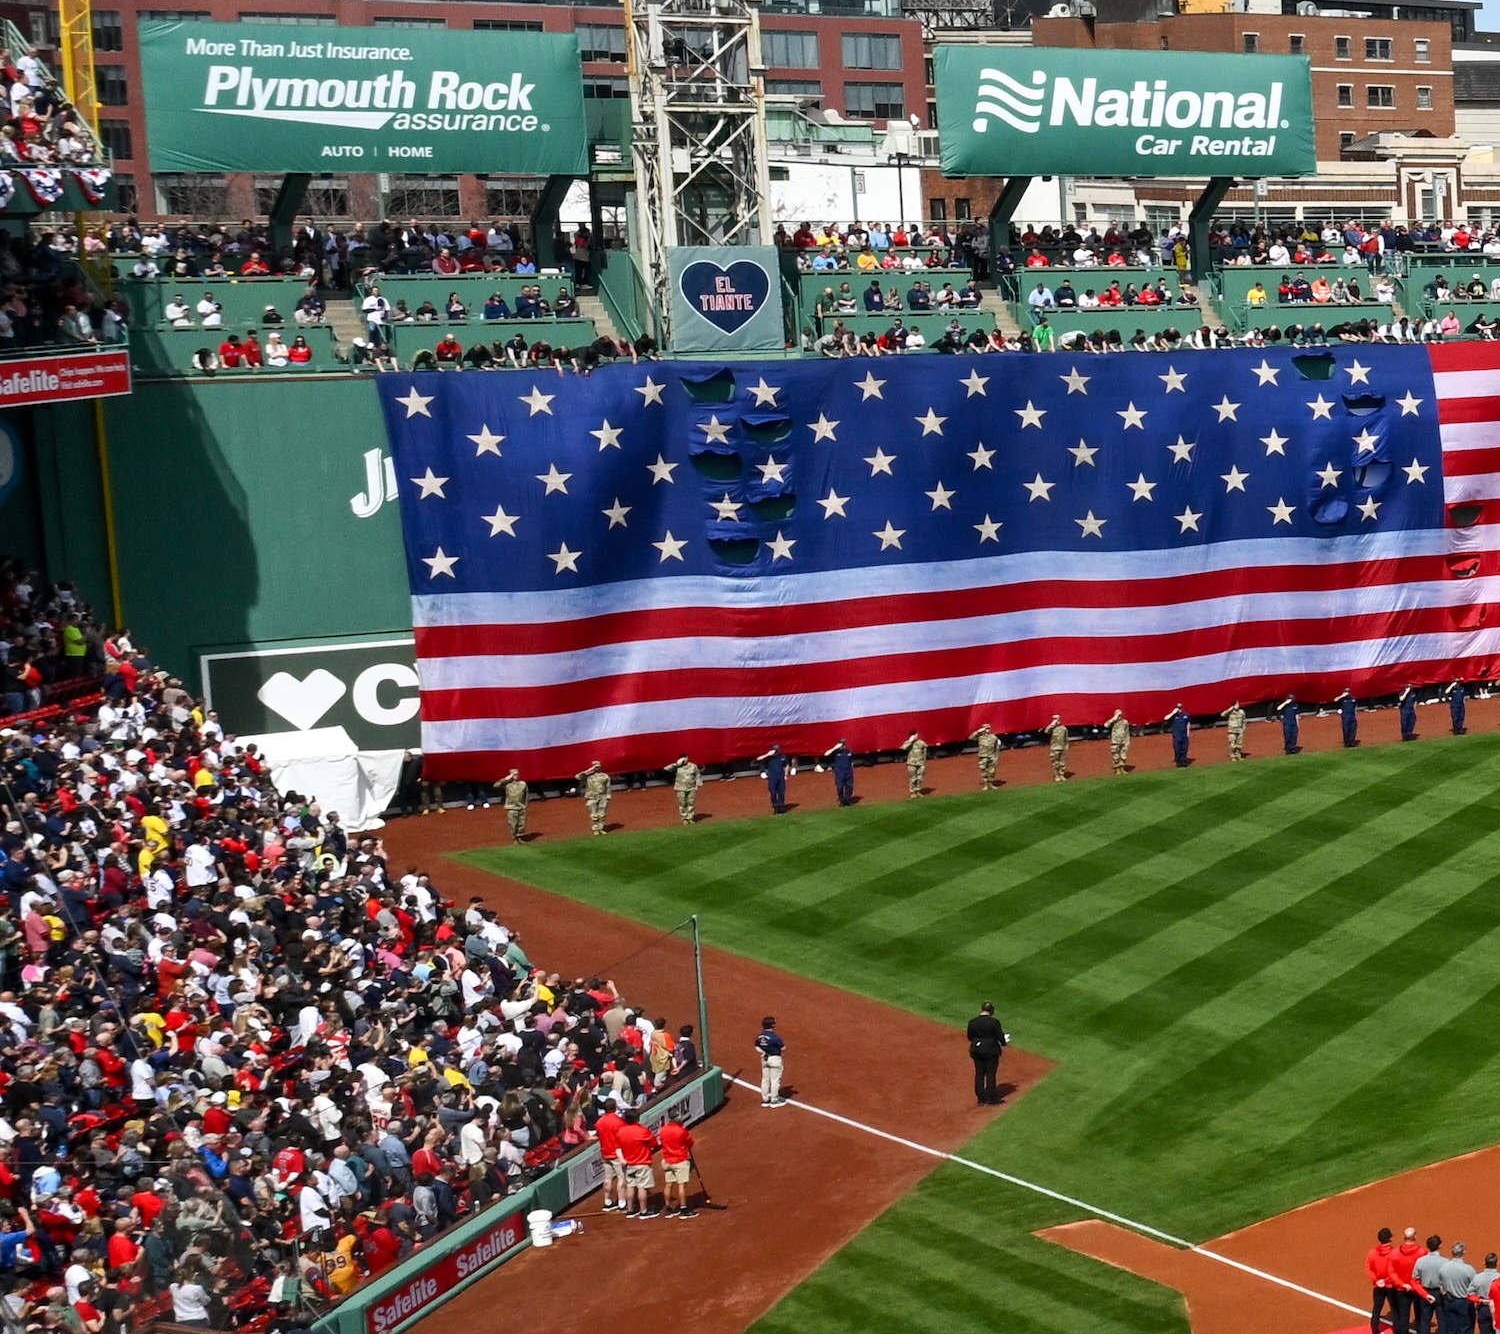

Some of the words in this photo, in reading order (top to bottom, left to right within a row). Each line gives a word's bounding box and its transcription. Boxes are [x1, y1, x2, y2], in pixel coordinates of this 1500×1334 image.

[186, 38, 236, 56] More
[240, 39, 284, 58] Than
[287, 42, 324, 59] Just
[327, 42, 414, 61] Insurance.
[203, 65, 416, 112] Plymouth
[427, 70, 536, 111] Rock
[1049, 76, 1283, 129] National
[393, 111, 538, 132] assurance
[321, 145, 364, 157] AUTO
[388, 146, 433, 158] HOME
[1135, 134, 1182, 156] Car
[1189, 134, 1276, 157] Rental
[715, 276, 736, 293] EL
[699, 294, 754, 312] TIANTE
[456, 1222, 516, 1278] Safelite
[372, 1275, 438, 1332] Safelite
